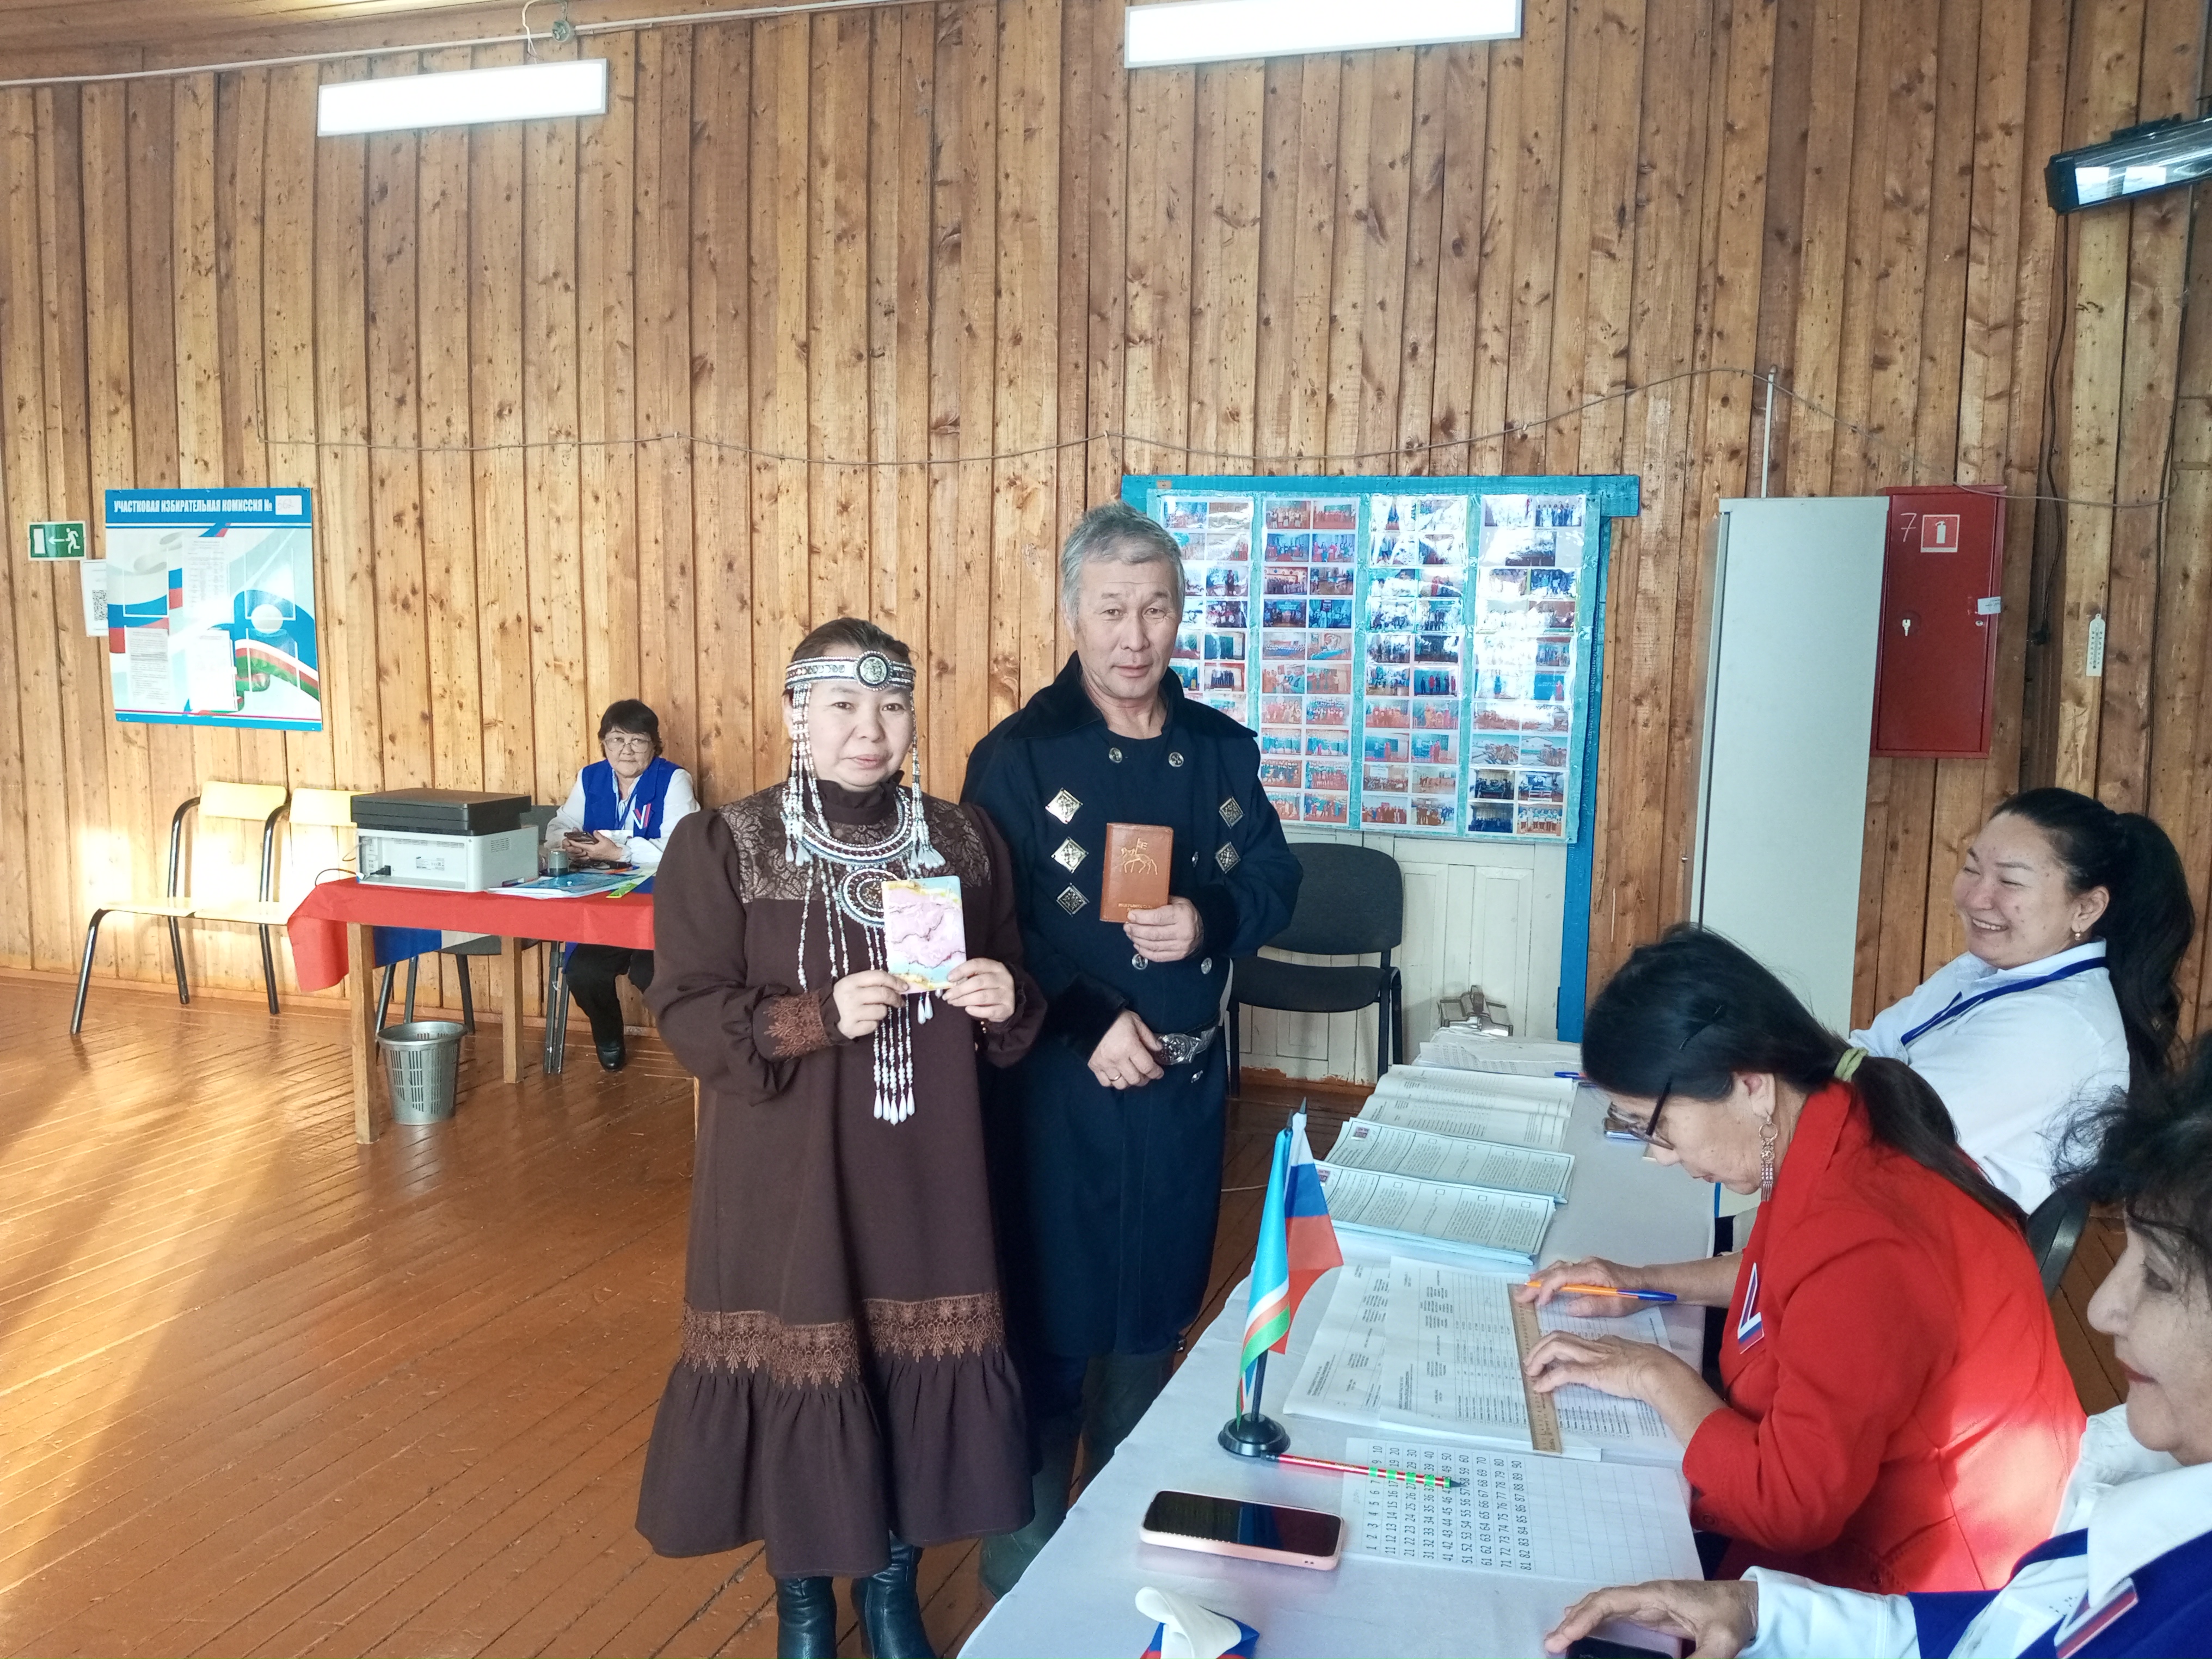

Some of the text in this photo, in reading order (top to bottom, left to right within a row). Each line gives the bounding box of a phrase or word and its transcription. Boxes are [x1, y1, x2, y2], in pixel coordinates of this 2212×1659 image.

[114, 499, 272, 513] УЧАСТКОВАЯ ИЗБИРАТЕЛЬНАЯ КОМИССИЯ №
[1900, 513, 1917, 543] 7
[1442, 1507, 1452, 1515] 45
[1404, 1526, 1415, 1534] 23
[1423, 1528, 1434, 1536] 33
[1518, 1527, 1528, 1535] 84
[1423, 1539, 1434, 1547] 32
[1442, 1541, 1453, 1550] 42
[1518, 1538, 1529, 1546] 83
[1461, 1544, 1472, 1552] 52
[1519, 1550, 1530, 1558] 82
